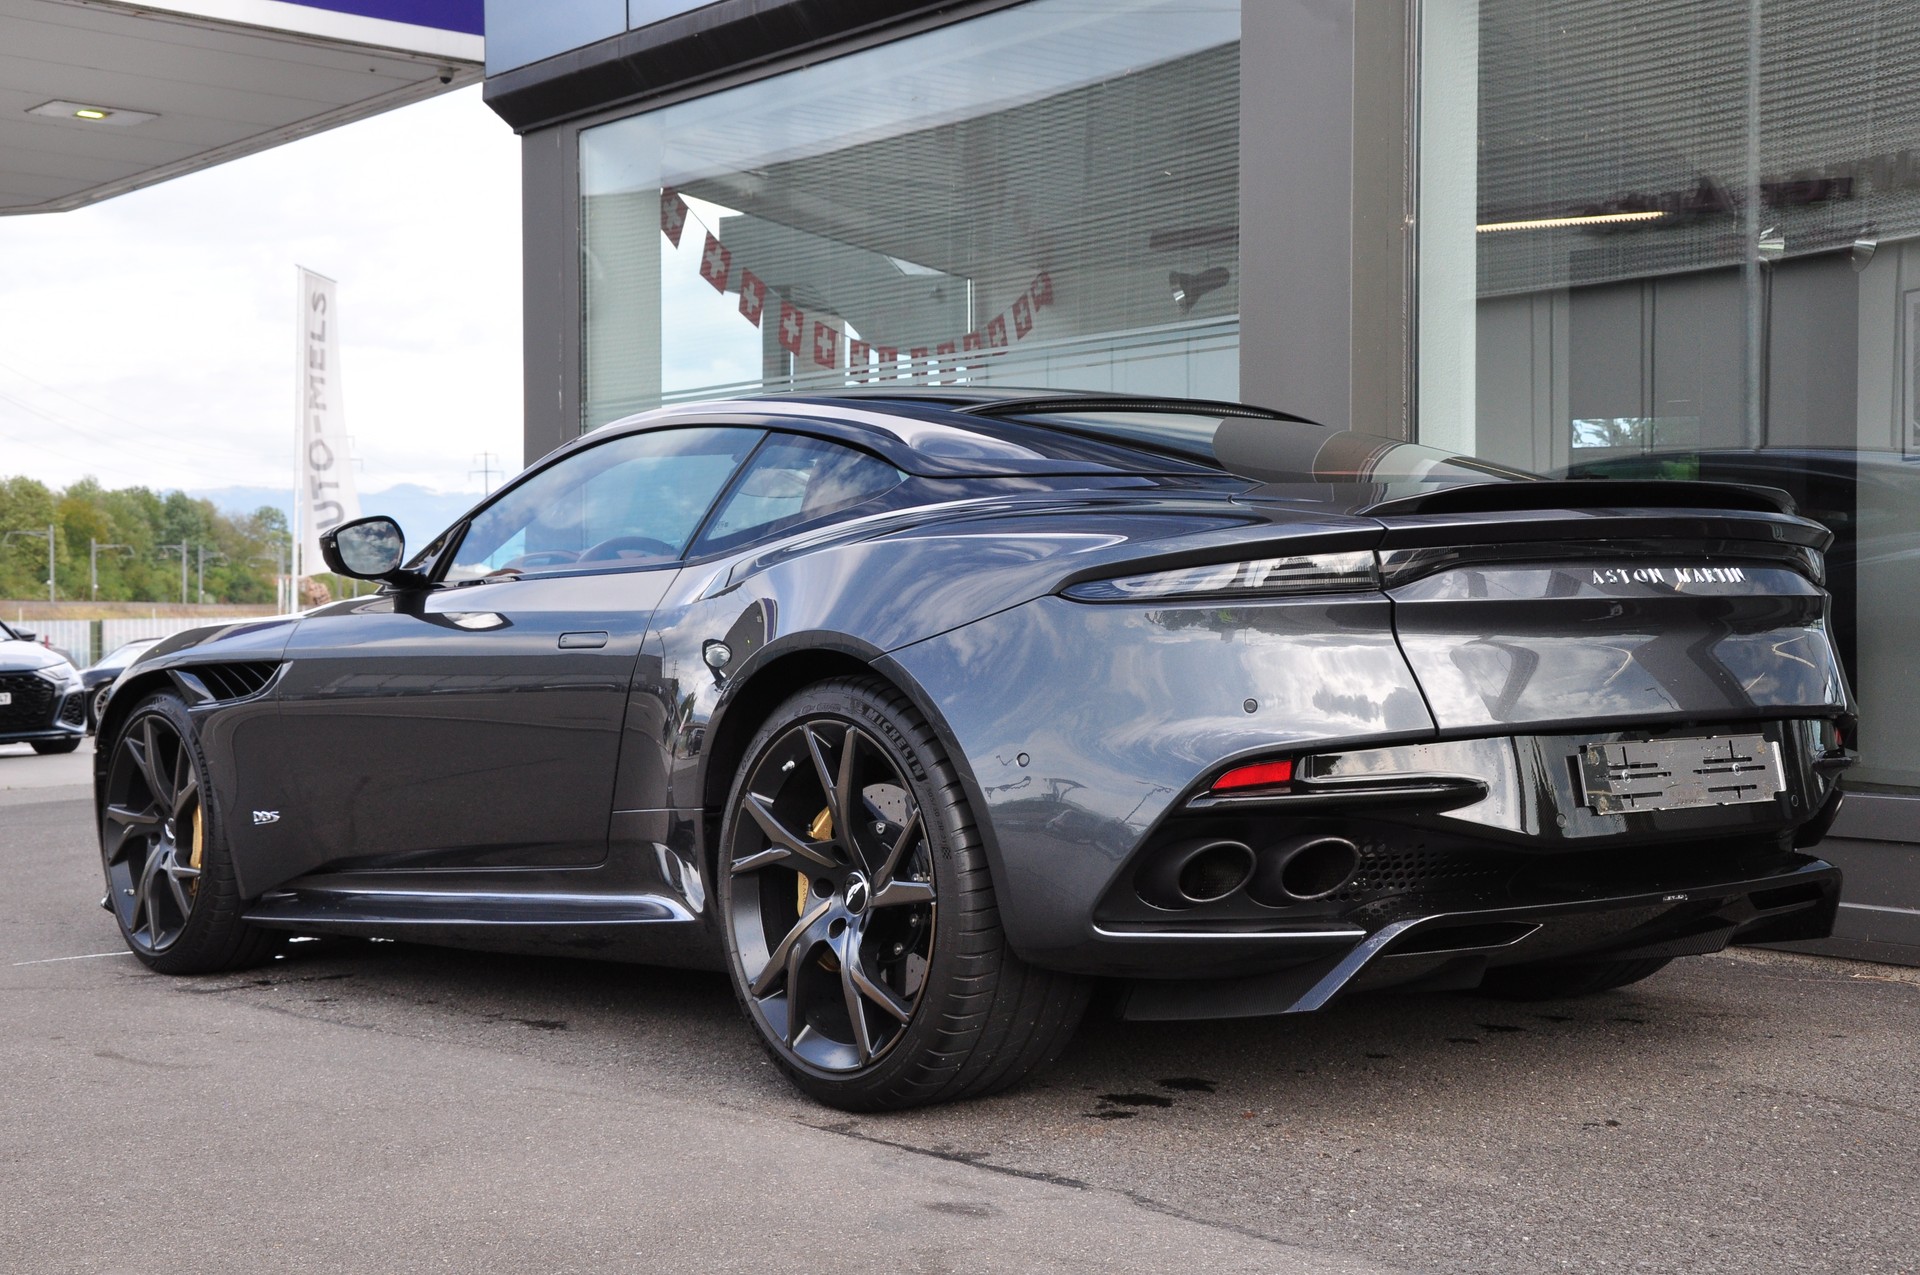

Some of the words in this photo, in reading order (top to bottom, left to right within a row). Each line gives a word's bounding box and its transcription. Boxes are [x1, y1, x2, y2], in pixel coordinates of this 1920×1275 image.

[307, 290, 345, 530] UTO-MELS
[1592, 567, 1665, 585] ASTON
[1674, 567, 1746, 584] MARTIN
[865, 708, 925, 777] MICHELIN
